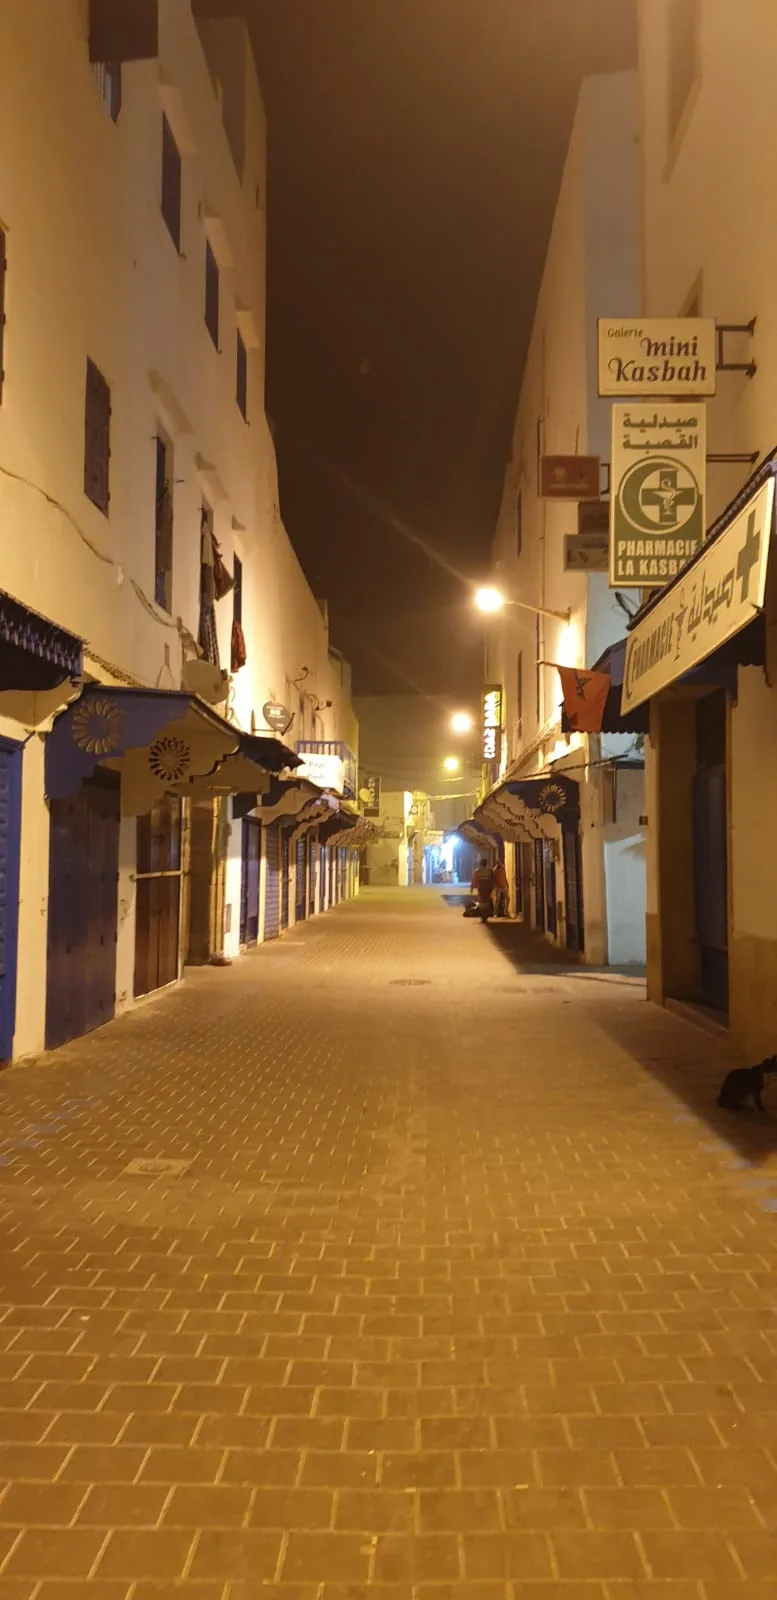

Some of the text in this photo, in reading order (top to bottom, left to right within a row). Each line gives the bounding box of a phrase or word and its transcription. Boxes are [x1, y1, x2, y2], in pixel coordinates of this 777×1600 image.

[607, 327, 643, 337] Galerie
[640, 336, 698, 357] mini
[607, 357, 706, 382] Kasbah
[622, 412, 698, 433] صيدلية
[622, 434, 698, 454] القصبة
[617, 540, 698, 556] PHARMACIE
[618, 560, 634, 576] LA
[687, 567, 736, 643] صيدلية
[631, 611, 675, 685] PHARMACIE
